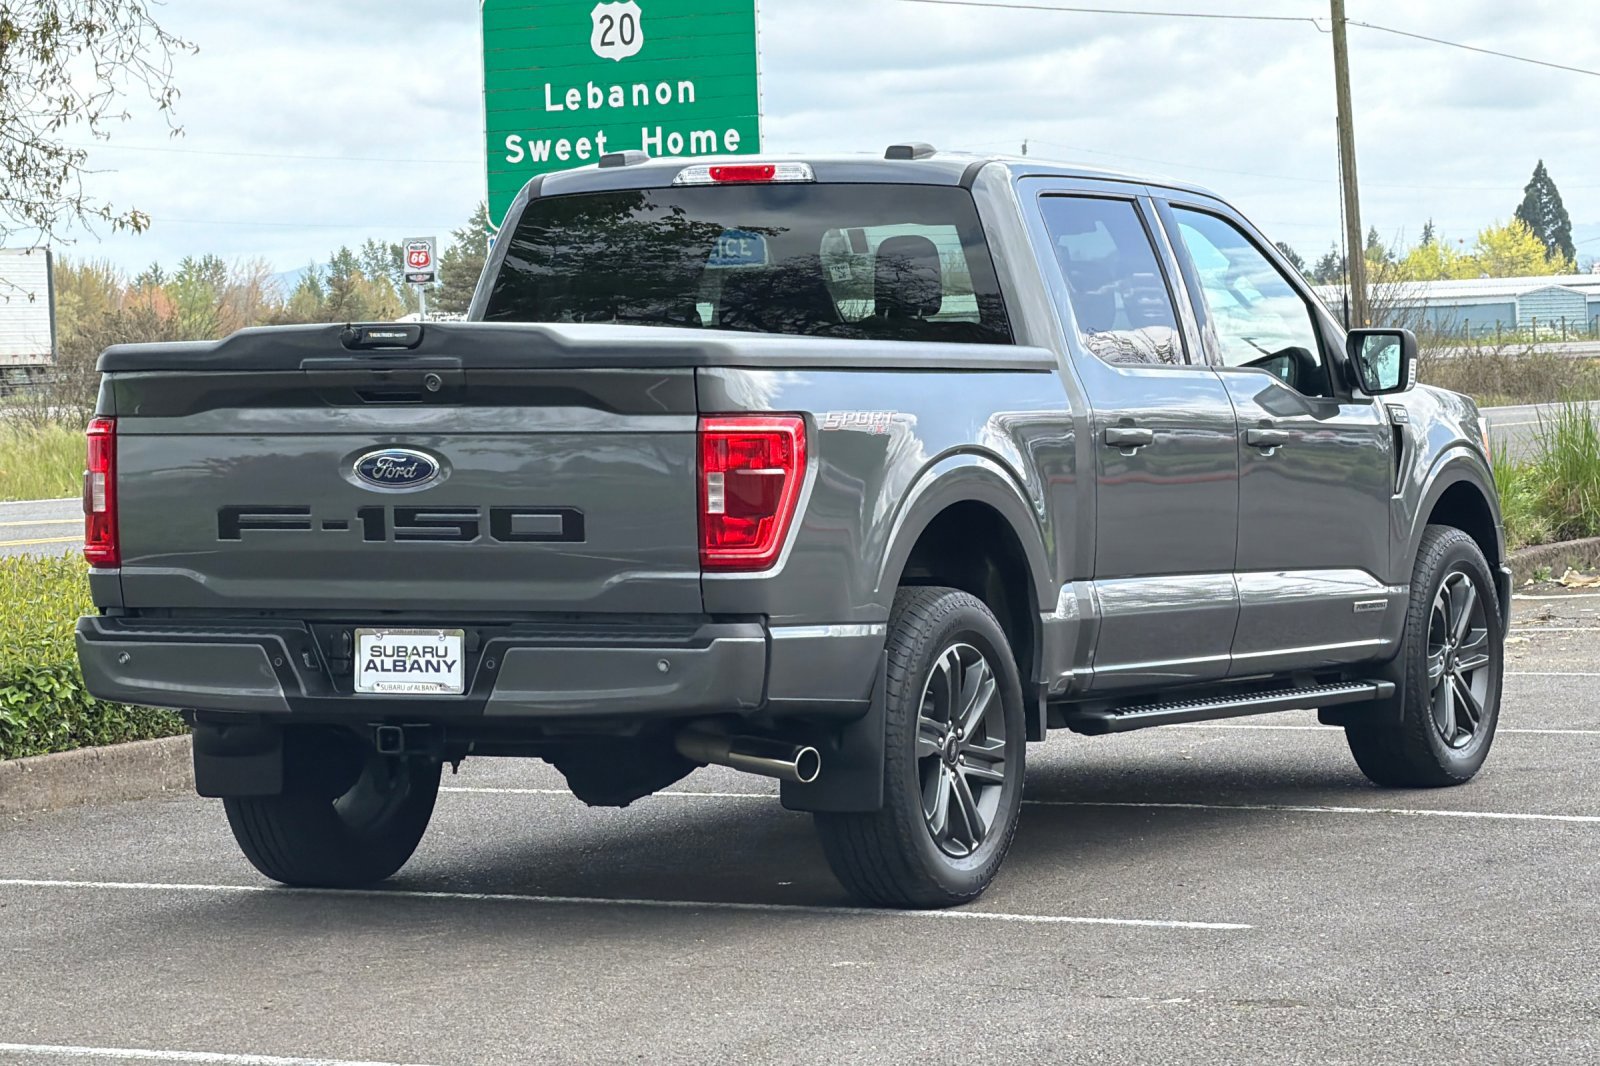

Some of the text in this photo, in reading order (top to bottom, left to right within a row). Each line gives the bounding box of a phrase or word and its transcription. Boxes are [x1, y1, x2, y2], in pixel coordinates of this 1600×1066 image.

[599, 12, 635, 47] 20
[544, 80, 696, 112] Lebanon
[505, 126, 741, 164] Sweet Home
[411, 252, 426, 264] 66
[823, 411, 896, 431] SPORT
[372, 456, 417, 480] Ford
[216, 505, 587, 543] F-150
[370, 645, 448, 658] SUBARU
[364, 659, 457, 673] ALBANY
